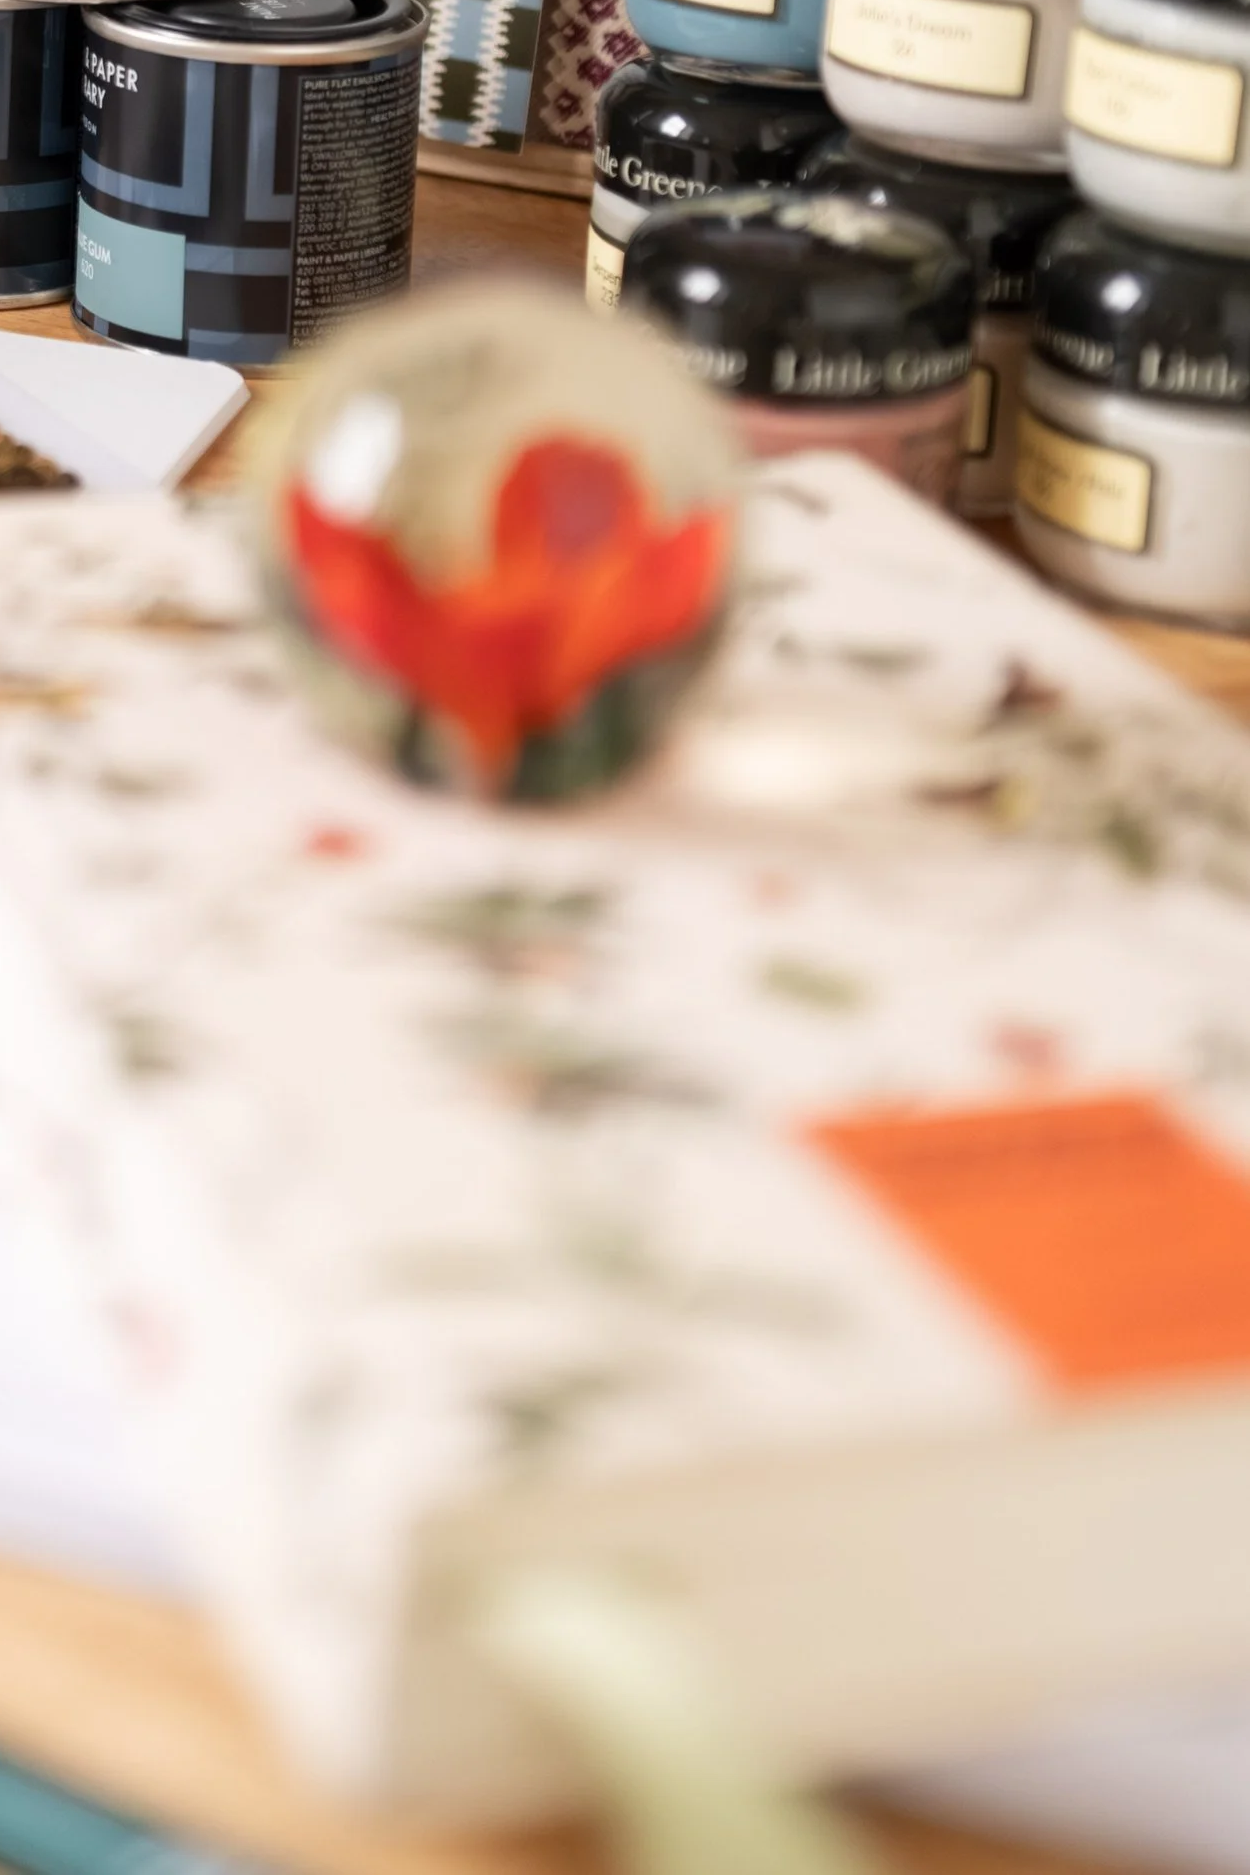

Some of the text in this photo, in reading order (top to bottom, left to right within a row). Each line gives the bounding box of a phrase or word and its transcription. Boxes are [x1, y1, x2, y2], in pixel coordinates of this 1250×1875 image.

[91, 52, 138, 93] PAPER
[594, 145, 723, 199] ttle Green
[88, 239, 111, 265] GUM
[297, 255, 324, 266] PAINT
[771, 343, 883, 395] Little
[1138, 340, 1249, 398] Little
